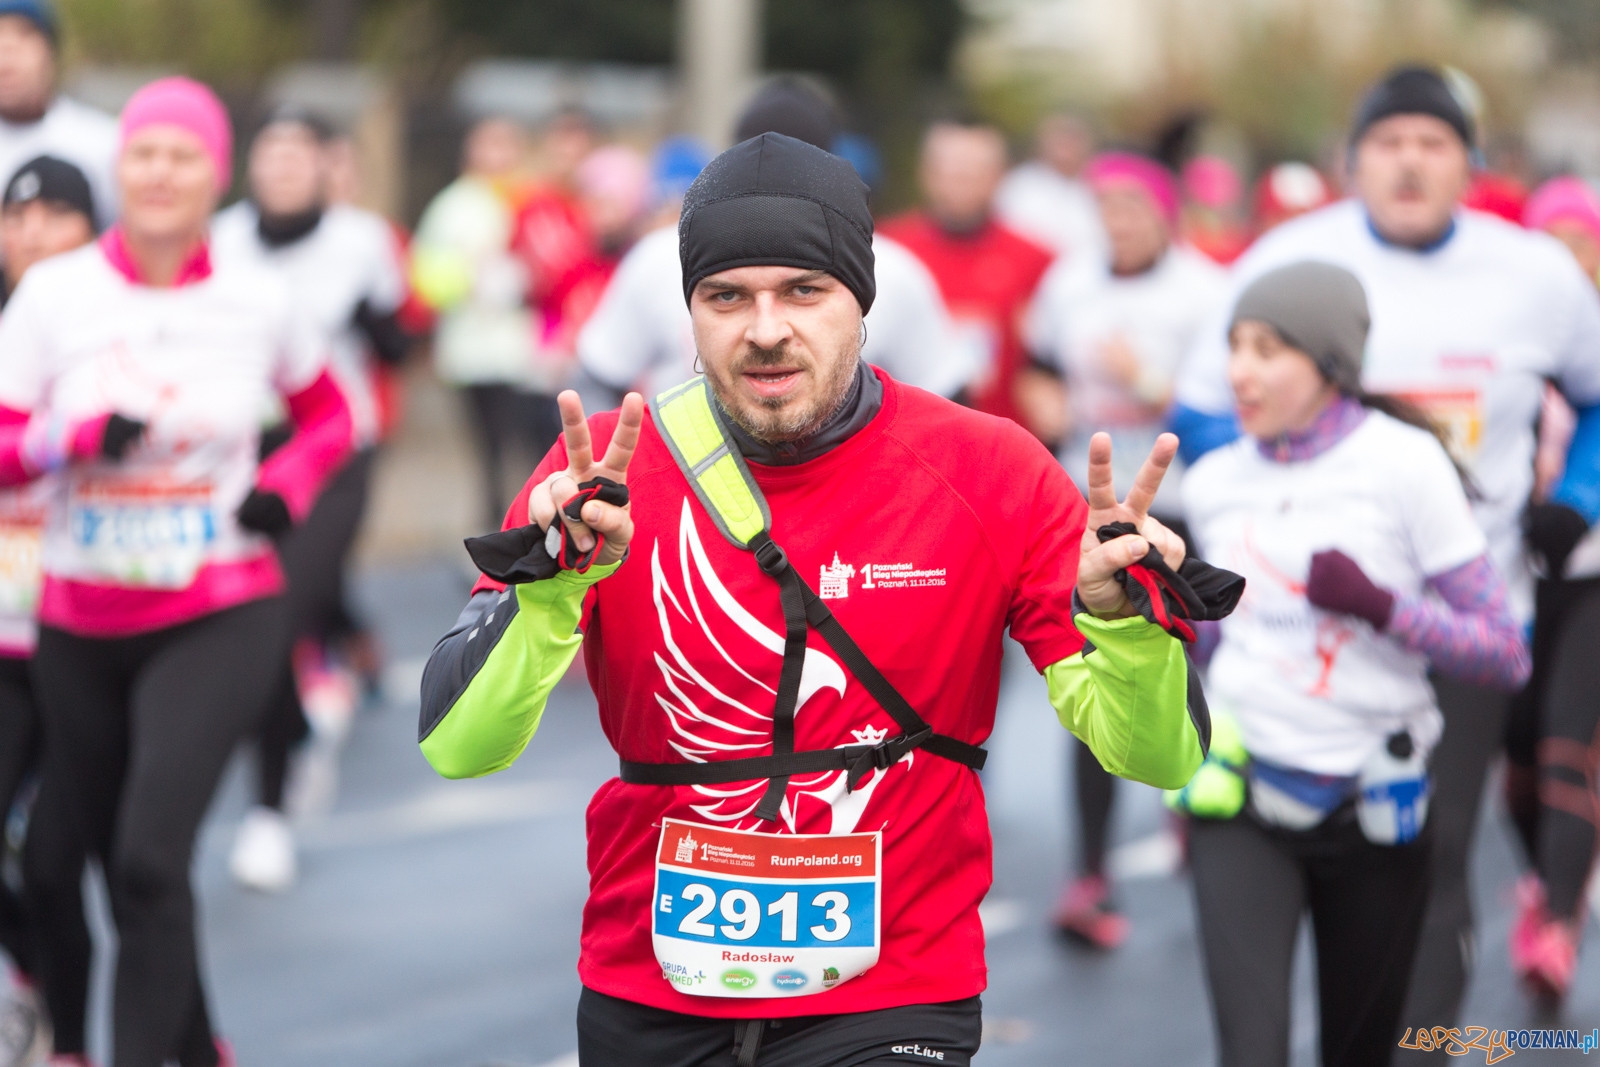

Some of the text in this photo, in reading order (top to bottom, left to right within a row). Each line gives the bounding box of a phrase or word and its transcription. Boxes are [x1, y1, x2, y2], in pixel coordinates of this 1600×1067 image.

[860, 563, 913, 589] 1 Poznański
[873, 571, 890, 579] Bieg
[909, 578, 946, 587] 11.11.2016
[701, 842, 709, 861] 1
[770, 853, 863, 867] RunPoland.org
[659, 883, 852, 942] E 2913
[721, 951, 795, 963] Radosław
[725, 977, 754, 986] energy
[891, 1044, 944, 1060] active
